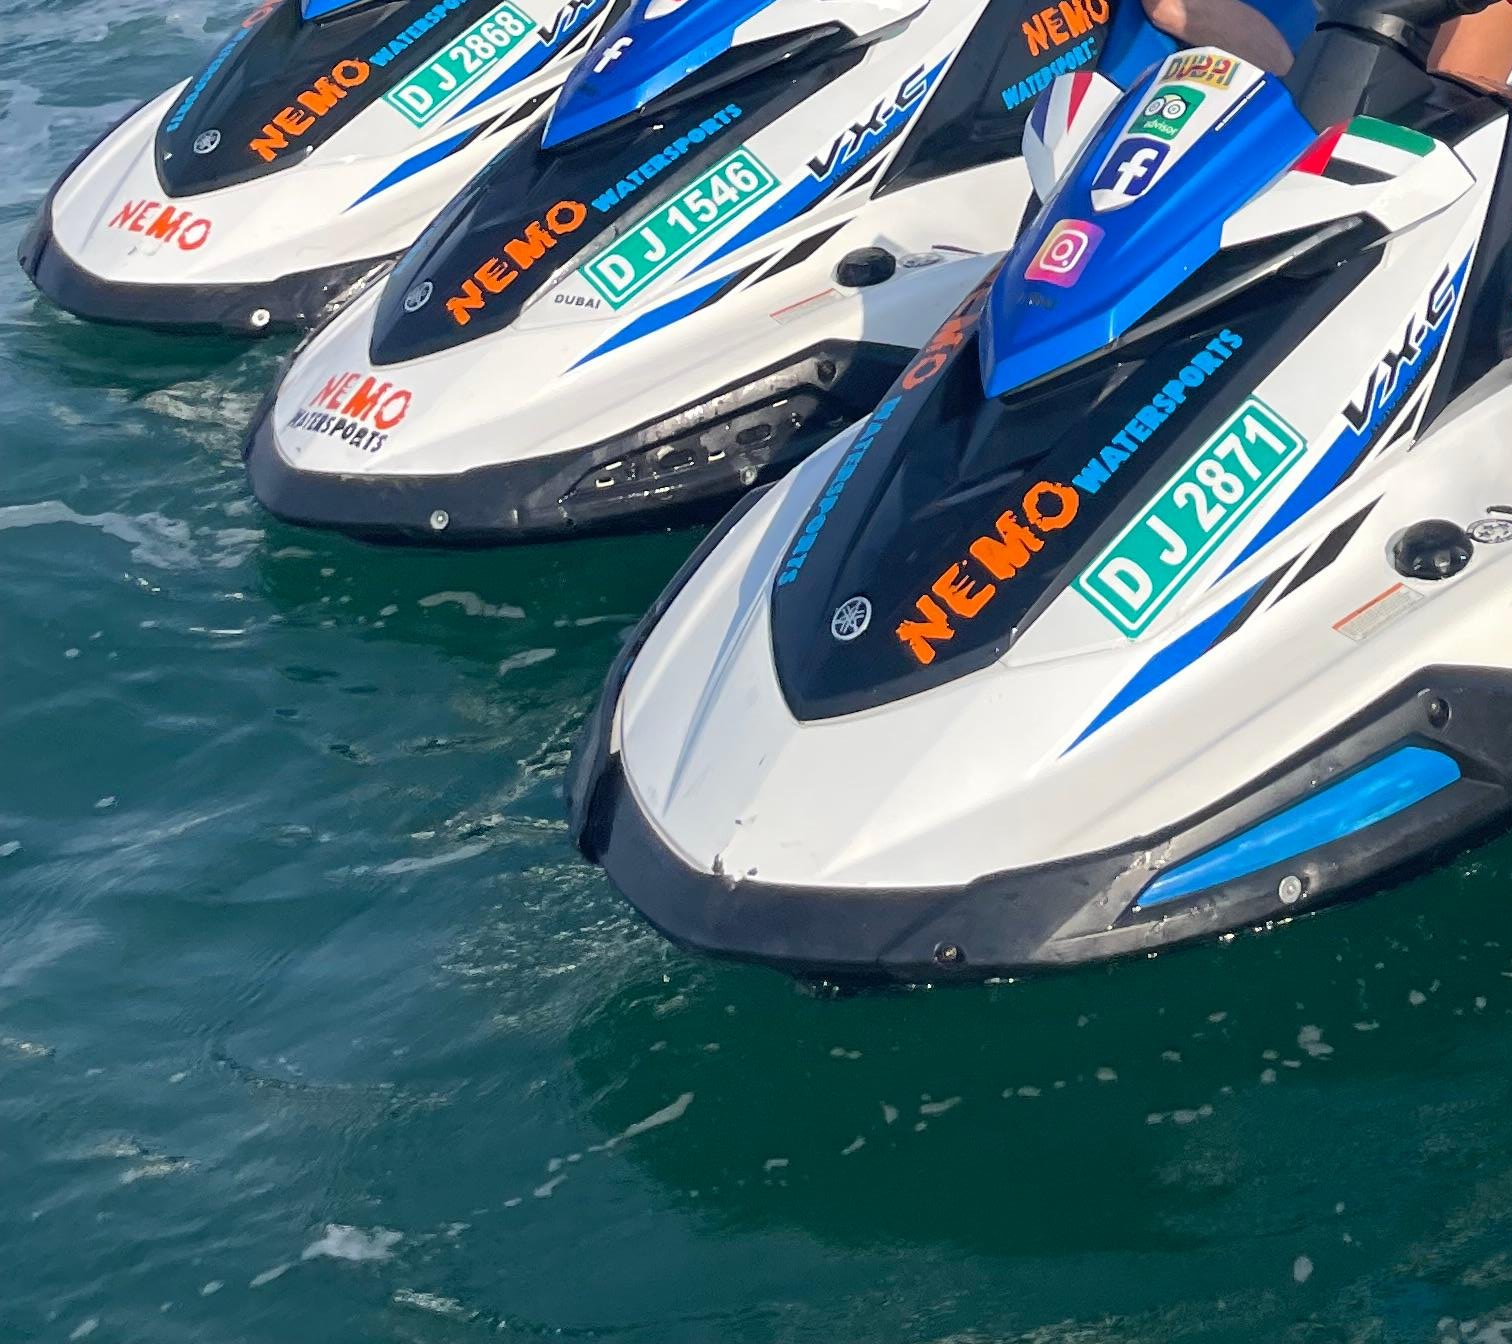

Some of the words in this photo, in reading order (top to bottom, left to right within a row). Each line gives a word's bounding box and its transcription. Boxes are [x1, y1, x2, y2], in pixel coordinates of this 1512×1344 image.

[449, 10, 526, 75] 2868
[592, 37, 634, 74] f
[250, 59, 371, 162] NEMO
[666, 160, 761, 236] 1546
[1114, 148, 1159, 196] f
[108, 200, 213, 251] NEMO
[444, 199, 588, 326] NEMO
[591, 103, 743, 212] WATERSPORTS
[554, 293, 601, 310] DUBAI
[287, 408, 388, 453] WATERSPORTS
[309, 371, 412, 430] NEMO
[896, 480, 1080, 665] NEMO
[1072, 329, 1244, 494] WATERSPORTS
[1172, 413, 1288, 533] 2871
